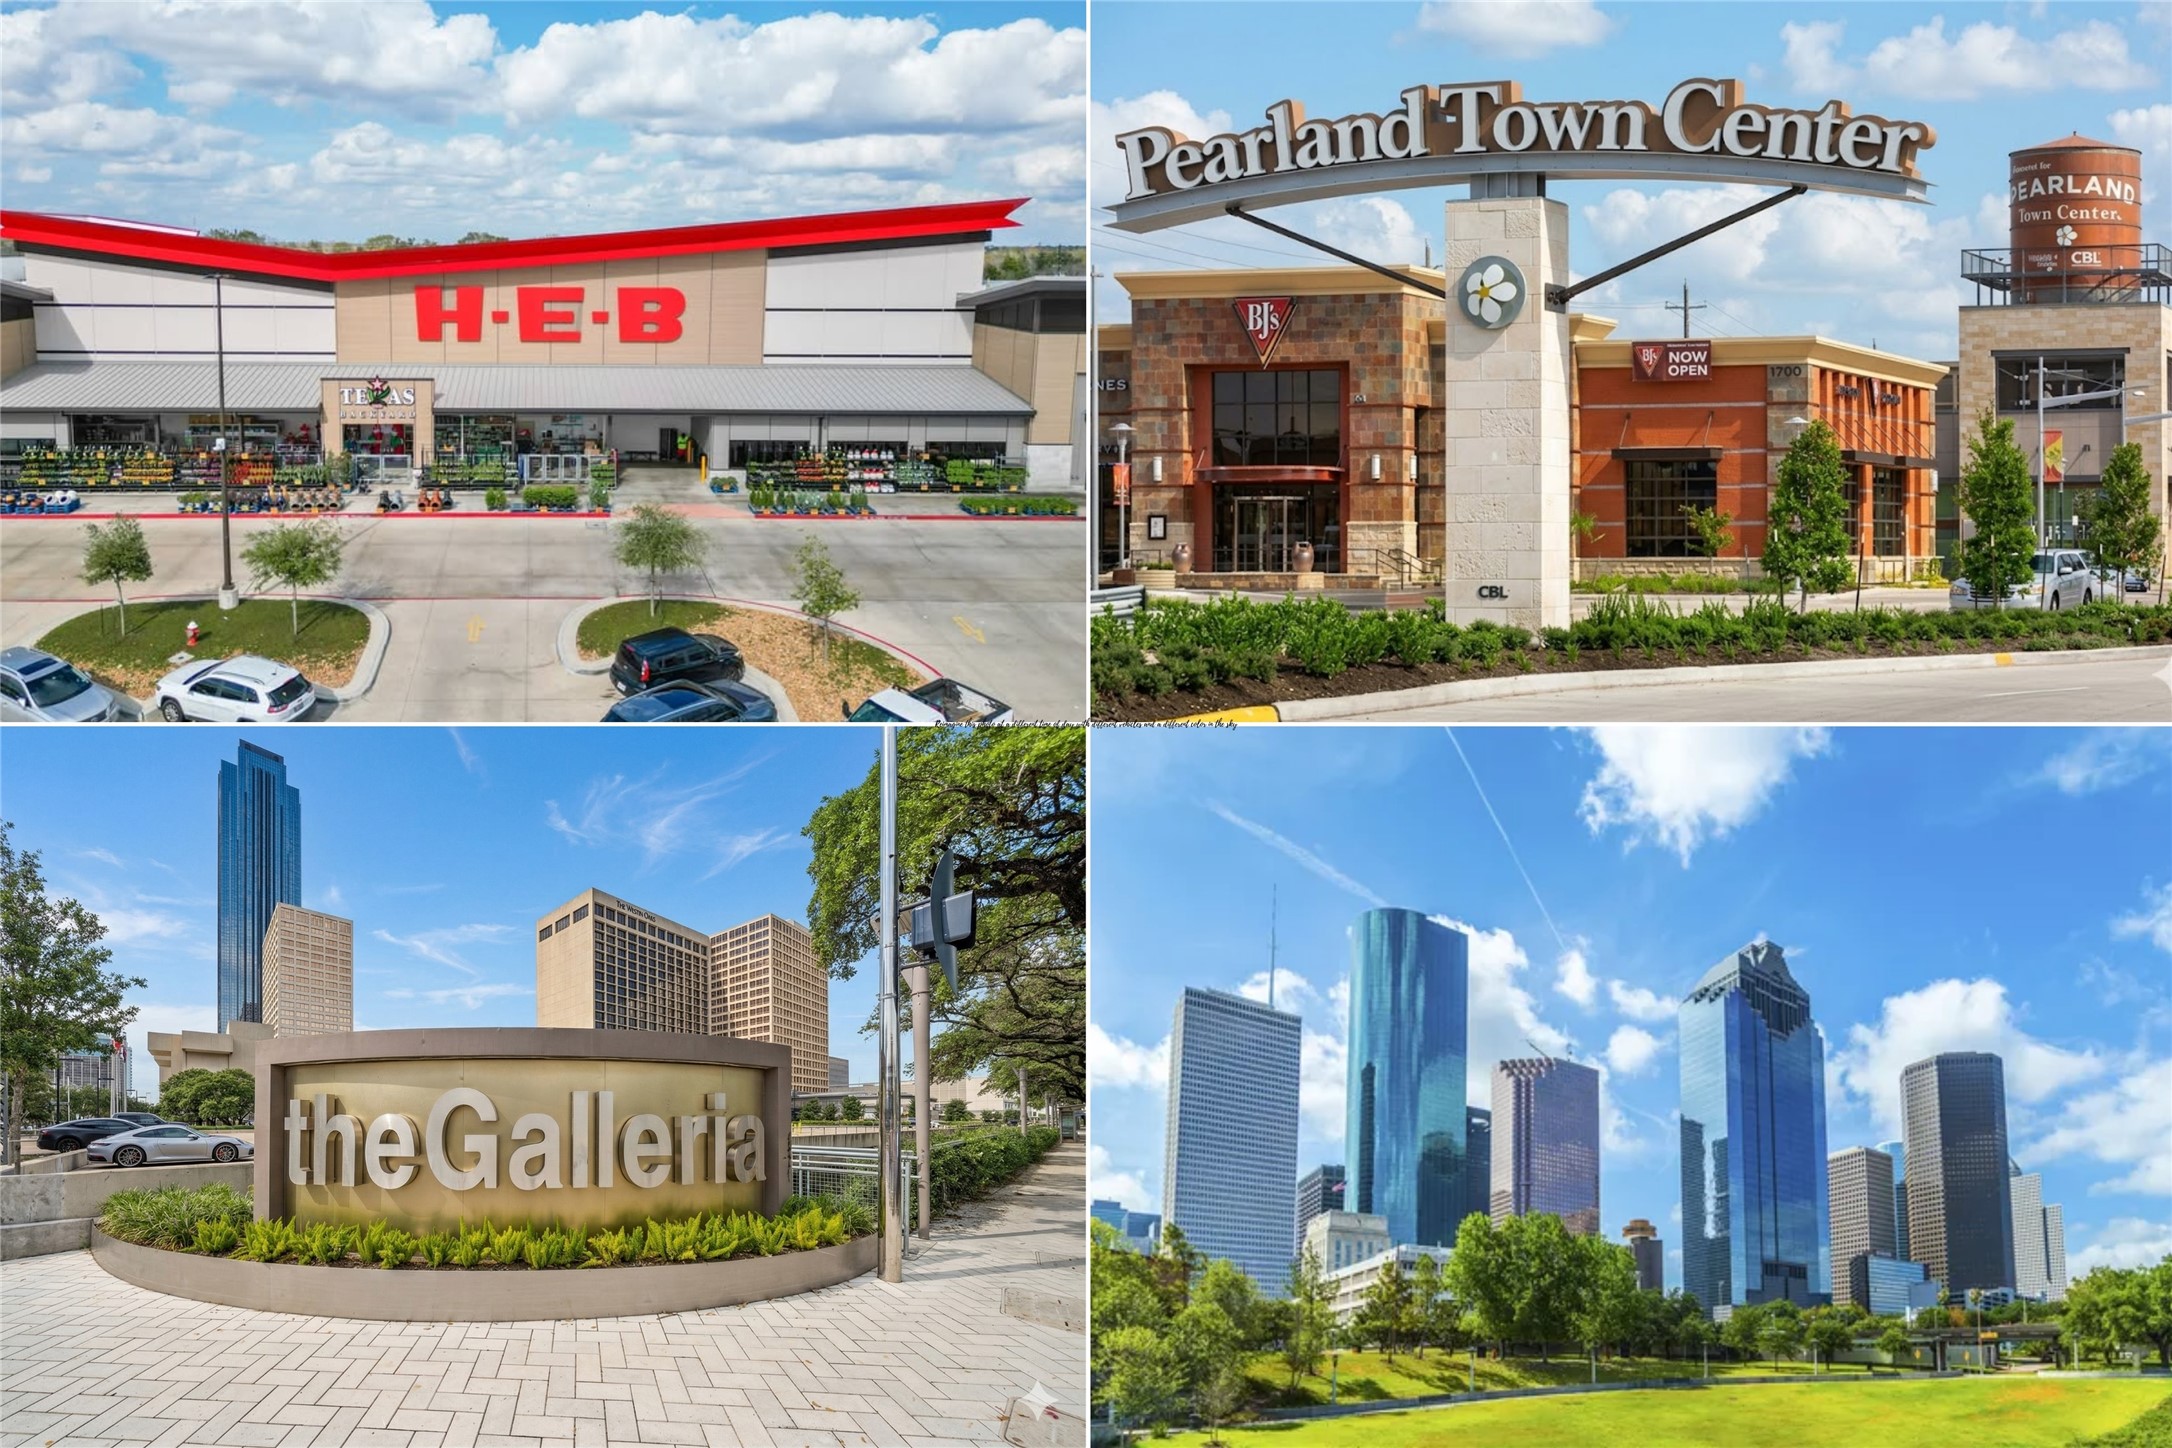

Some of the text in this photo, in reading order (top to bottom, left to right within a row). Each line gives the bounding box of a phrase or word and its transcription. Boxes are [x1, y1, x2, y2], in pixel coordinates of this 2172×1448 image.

[1116, 78, 1928, 201] Pearland Town Center
[2011, 174, 2135, 205] PEARLAND
[2019, 207, 2052, 223] Town
[2071, 251, 2102, 264] CBL
[414, 285, 687, 343] H-E-B
[1247, 302, 1280, 339] BJ's
[1668, 351, 1708, 364] NOW
[1668, 364, 1708, 376] OPEN
[1770, 366, 1802, 377] 1700
[1091, 379, 1127, 391] NES
[340, 411, 416, 419] BACKYARD
[1478, 585, 1508, 599] CBL
